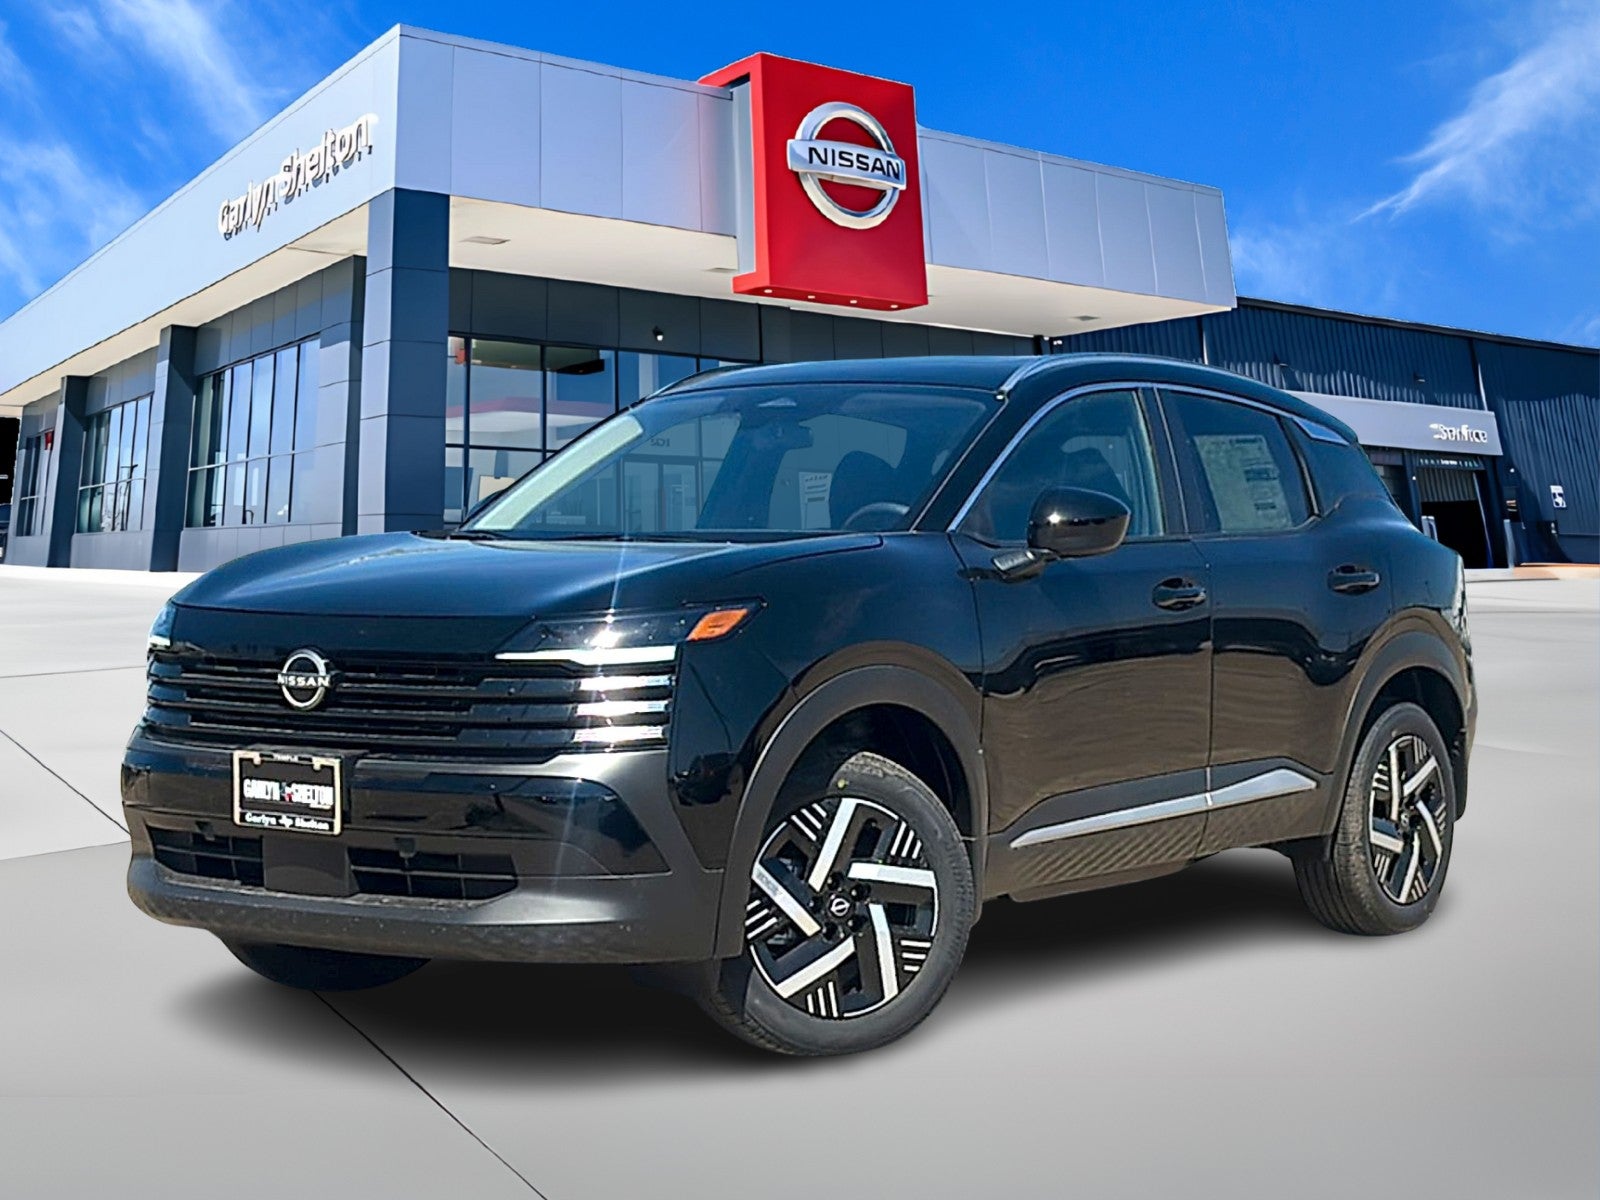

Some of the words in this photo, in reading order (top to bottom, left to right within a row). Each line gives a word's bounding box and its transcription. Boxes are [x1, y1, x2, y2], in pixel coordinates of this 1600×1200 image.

[278, 115, 377, 205] Shelton
[808, 147, 900, 181] NISSAN
[277, 673, 330, 687] NISSAN
